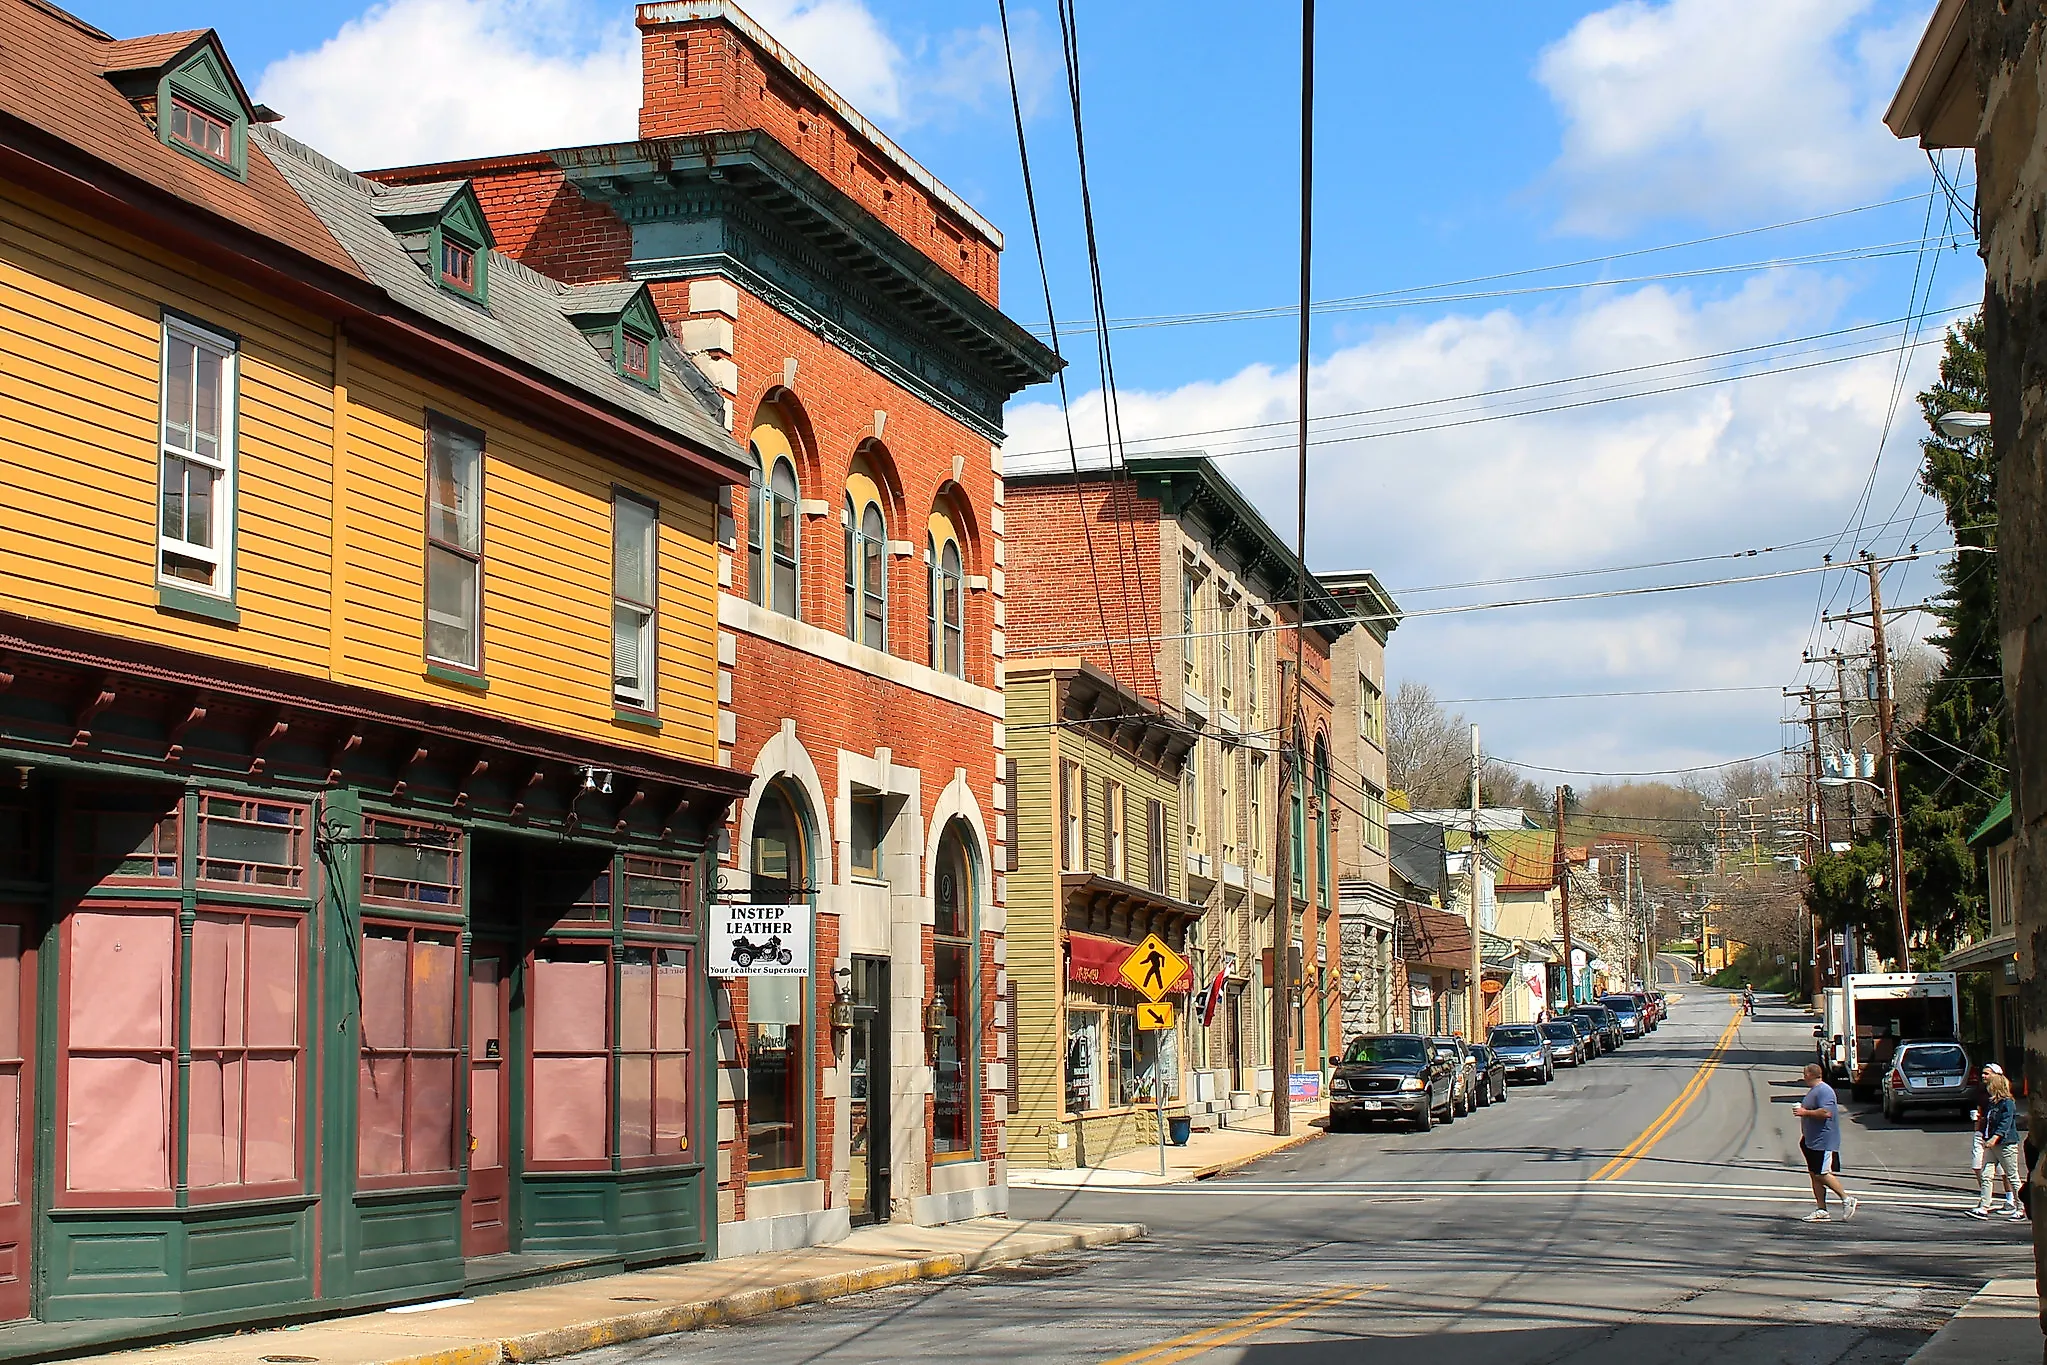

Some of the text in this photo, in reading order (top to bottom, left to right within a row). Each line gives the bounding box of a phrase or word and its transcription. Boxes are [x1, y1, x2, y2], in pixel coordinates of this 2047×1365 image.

[731, 908, 784, 919] INSTEP
[726, 922, 792, 934] LEATHER
[710, 966, 807, 975] Your Leather Superstore
